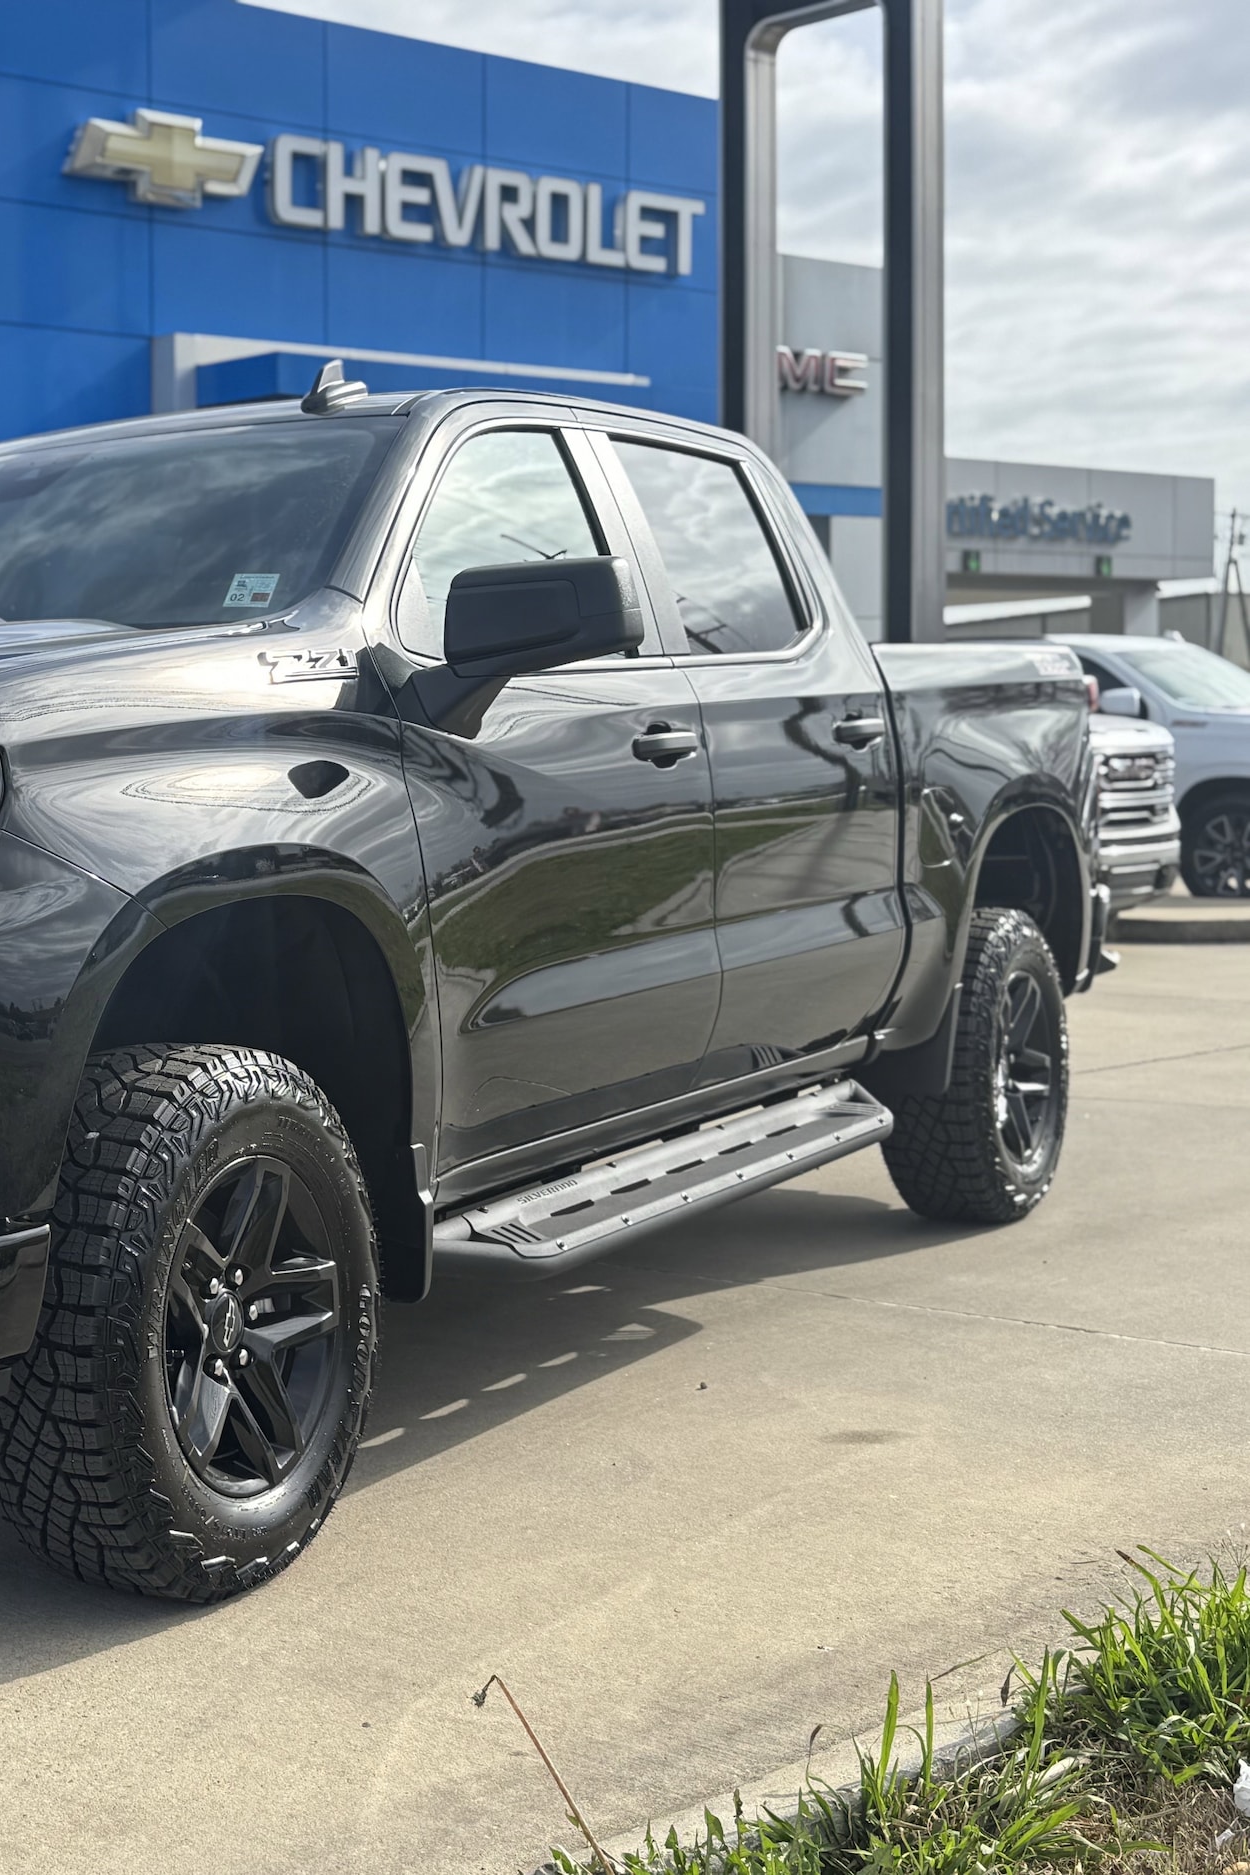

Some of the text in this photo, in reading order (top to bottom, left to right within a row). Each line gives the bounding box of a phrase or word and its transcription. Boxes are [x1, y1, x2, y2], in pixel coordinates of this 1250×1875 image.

[269, 133, 706, 276] CHEVROLET
[776, 345, 868, 397] MC
[516, 1179, 579, 1205] SILVERADO
